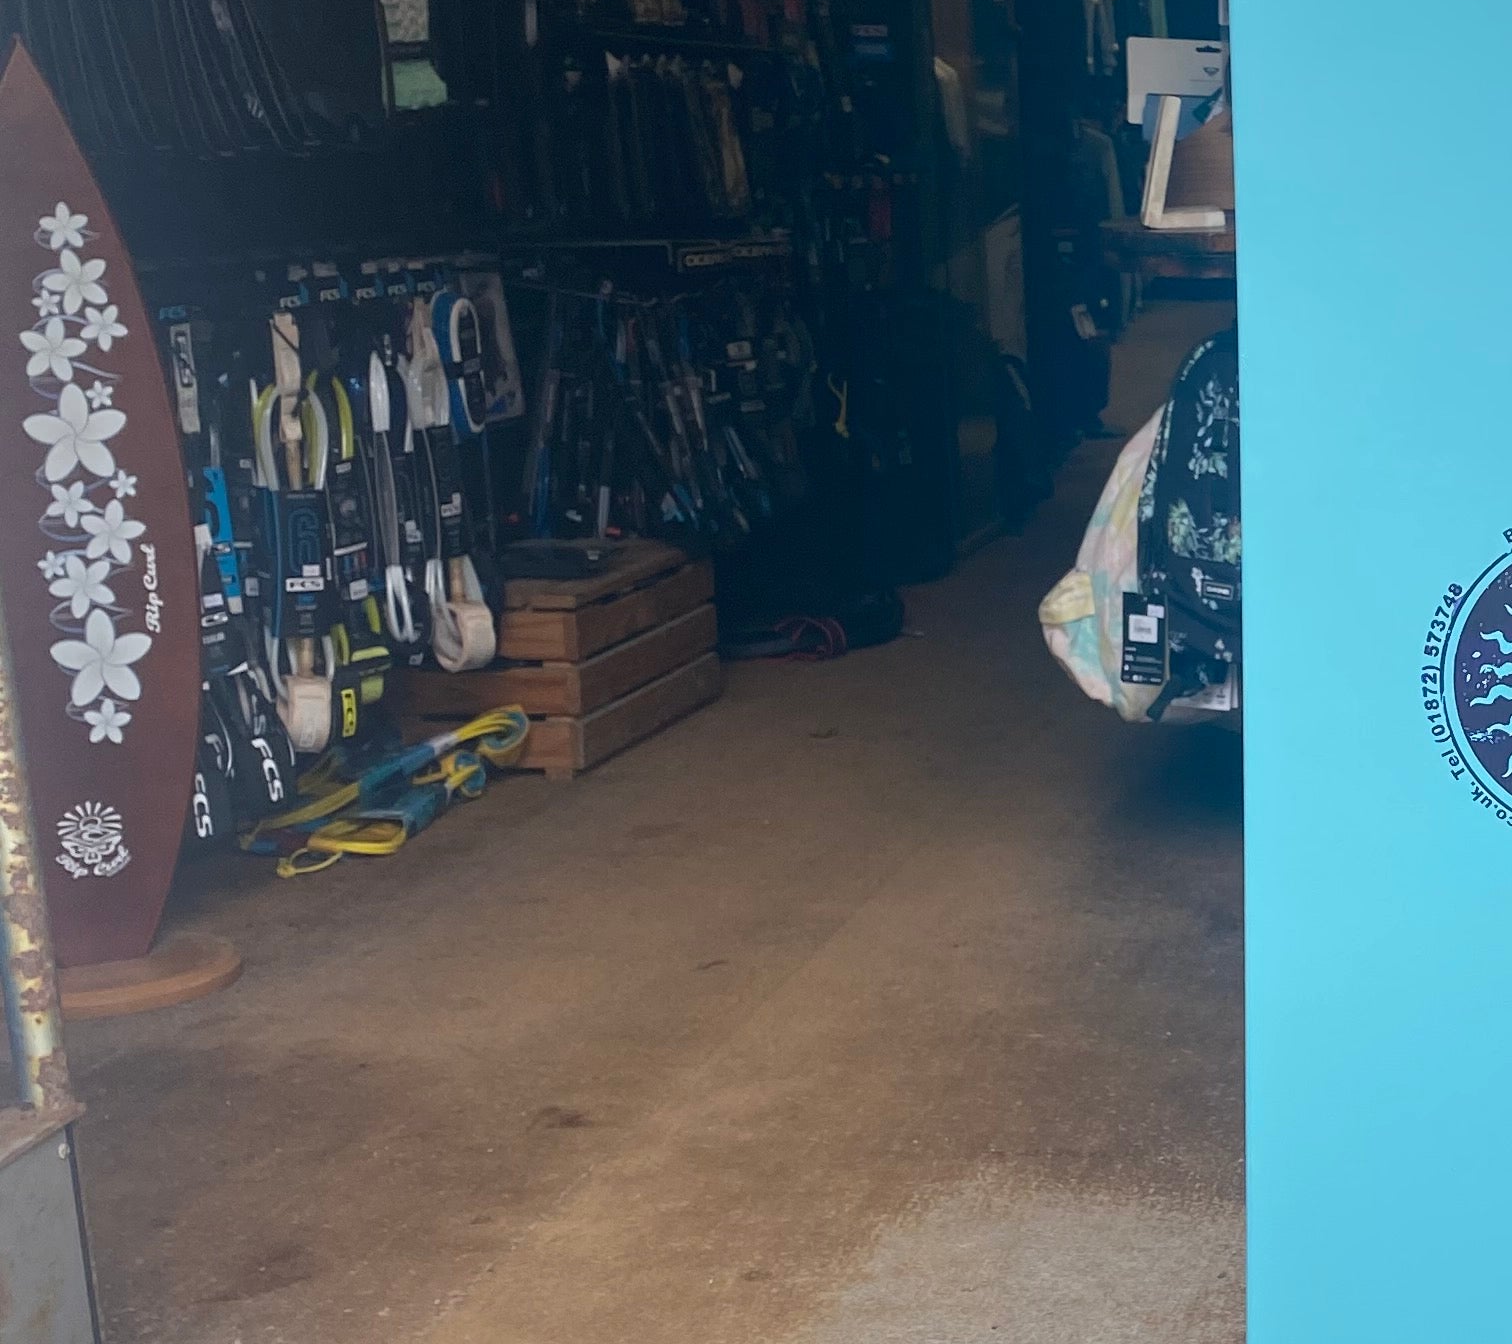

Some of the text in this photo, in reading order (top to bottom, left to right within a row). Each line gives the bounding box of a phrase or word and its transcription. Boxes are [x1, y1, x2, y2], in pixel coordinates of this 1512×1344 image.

[139, 542, 164, 634] Rip Curl
[1421, 583, 1465, 781] Tel (01872) 573748
[251, 737, 284, 803] FCS
